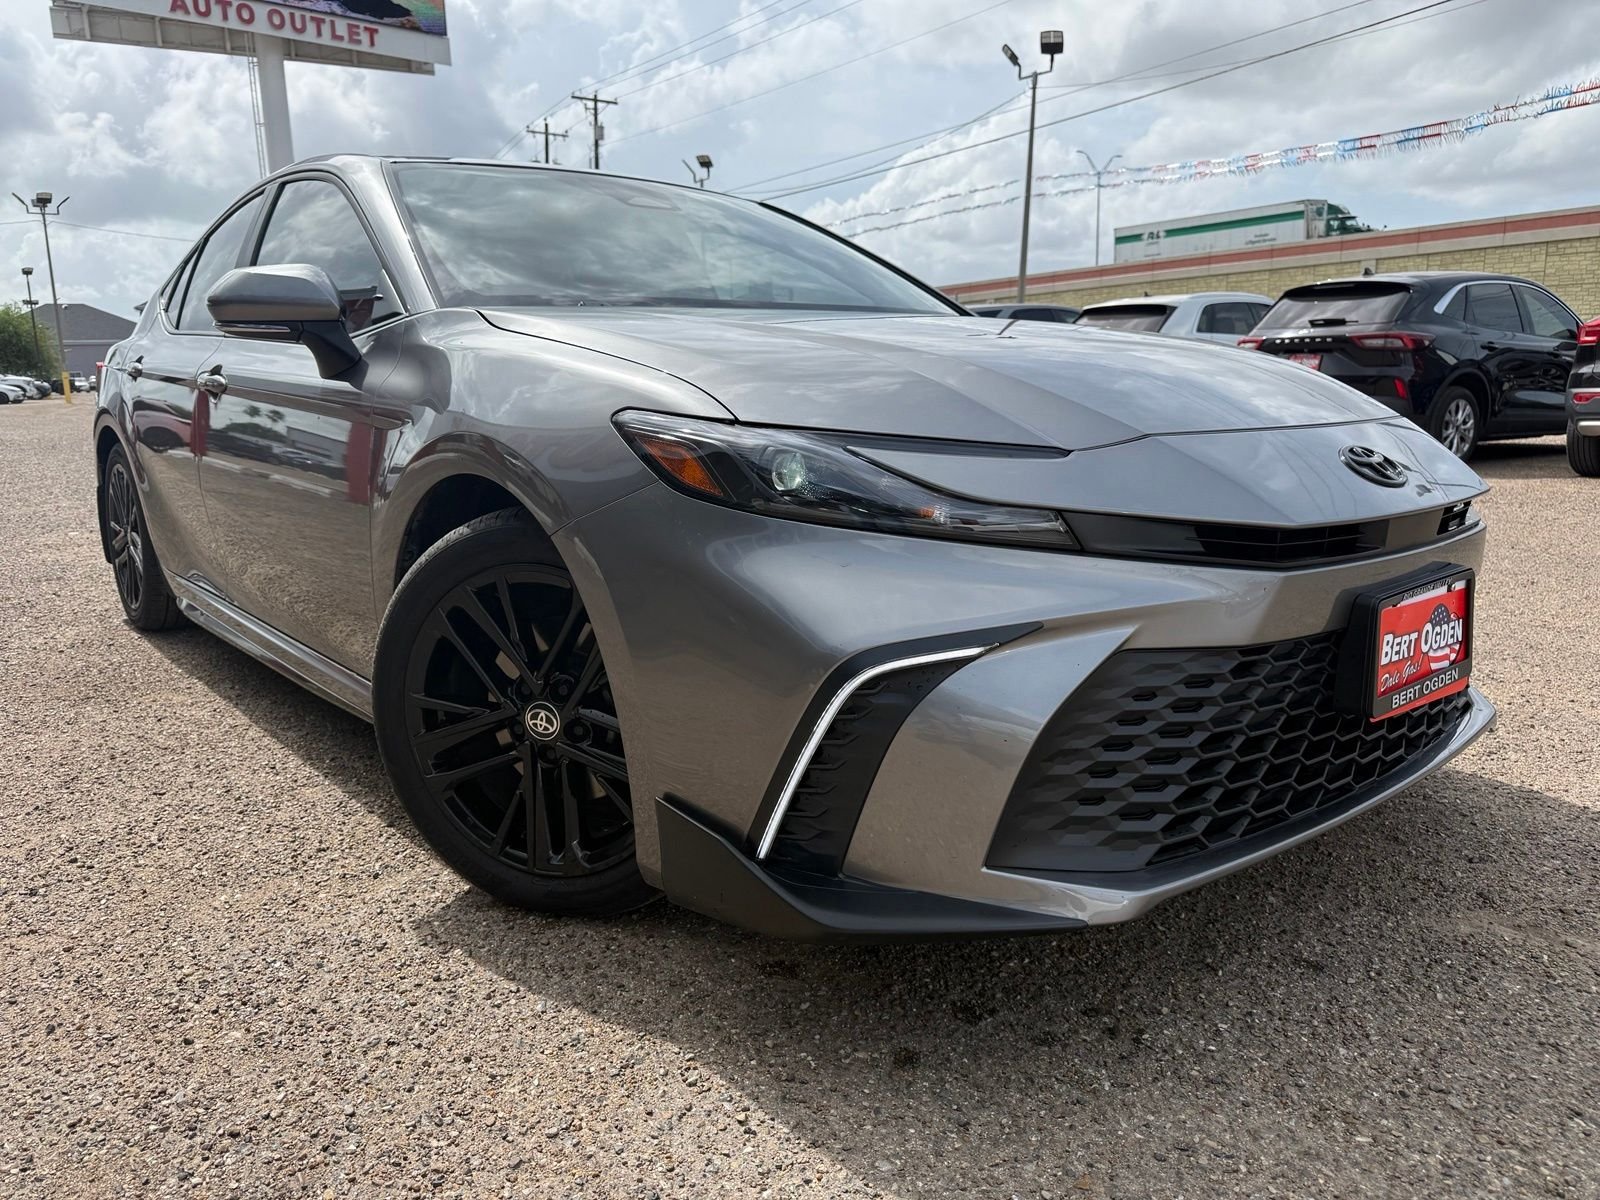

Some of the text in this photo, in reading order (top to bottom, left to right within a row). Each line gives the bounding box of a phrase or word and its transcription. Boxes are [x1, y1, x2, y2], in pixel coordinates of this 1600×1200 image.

[169, 0, 379, 47] AUTO OUTLET
[1381, 619, 1462, 665] BERT OGDEN
[1380, 670, 1400, 692] Dale
[1392, 668, 1458, 709] BERT OGDEN
